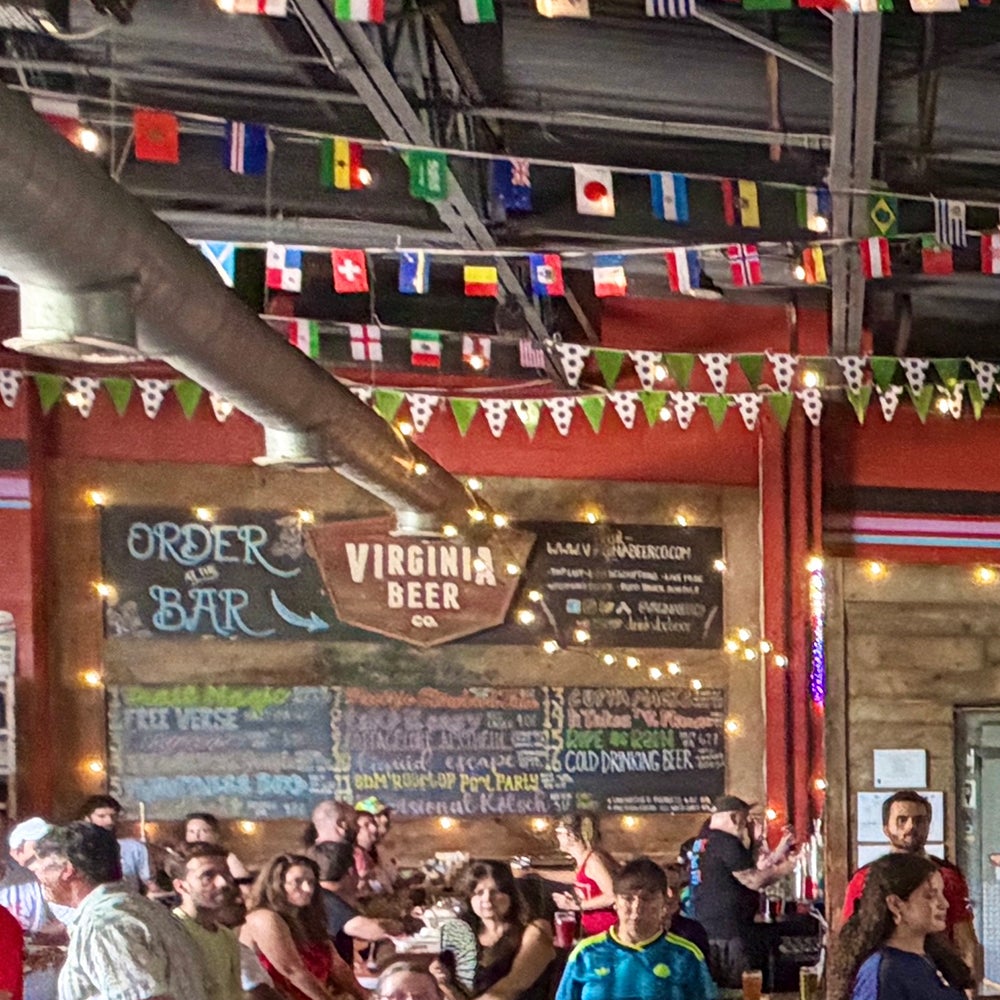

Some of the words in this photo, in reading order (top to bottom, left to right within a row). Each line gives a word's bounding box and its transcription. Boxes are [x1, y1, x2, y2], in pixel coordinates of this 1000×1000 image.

[127, 521, 300, 578] ORDER
[344, 542, 497, 587] VIRGINIA
[149, 584, 277, 637] BAR
[387, 581, 461, 610] BEER
[564, 750, 600, 773] COLD
[601, 750, 660, 774] DRINKING
[662, 748, 694, 772] BEER
[495, 772, 539, 792] PARTY
